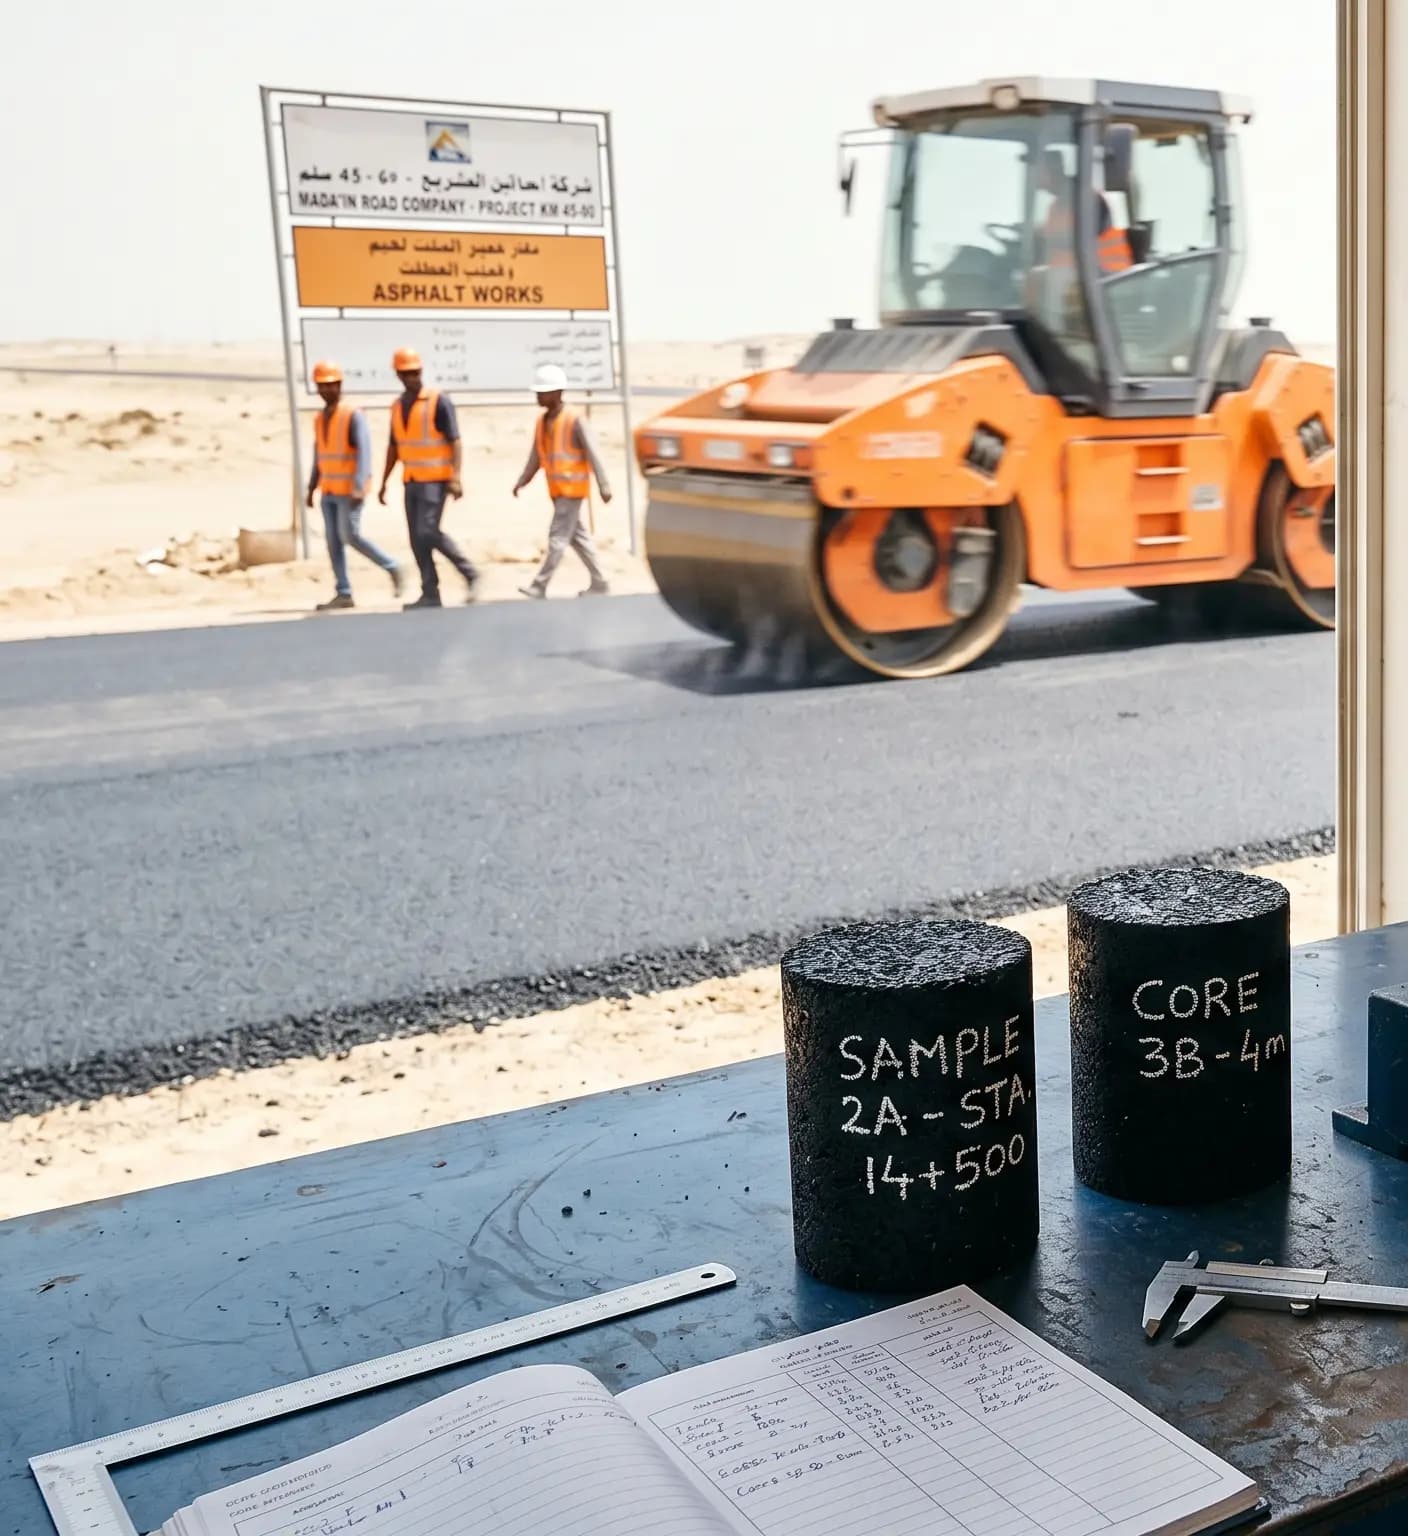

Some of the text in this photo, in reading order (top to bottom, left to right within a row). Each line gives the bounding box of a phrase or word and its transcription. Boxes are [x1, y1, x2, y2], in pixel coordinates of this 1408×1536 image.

[361, 194, 398, 211] ROAD
[402, 195, 465, 214] COMPANY
[479, 199, 535, 217] PROJECT
[373, 283, 544, 304] ASPHALT WORKS
[1132, 971, 1260, 1021] CORE
[839, 1014, 1021, 1082] SAMPLE
[866, 1133, 1026, 1201] 14+500
